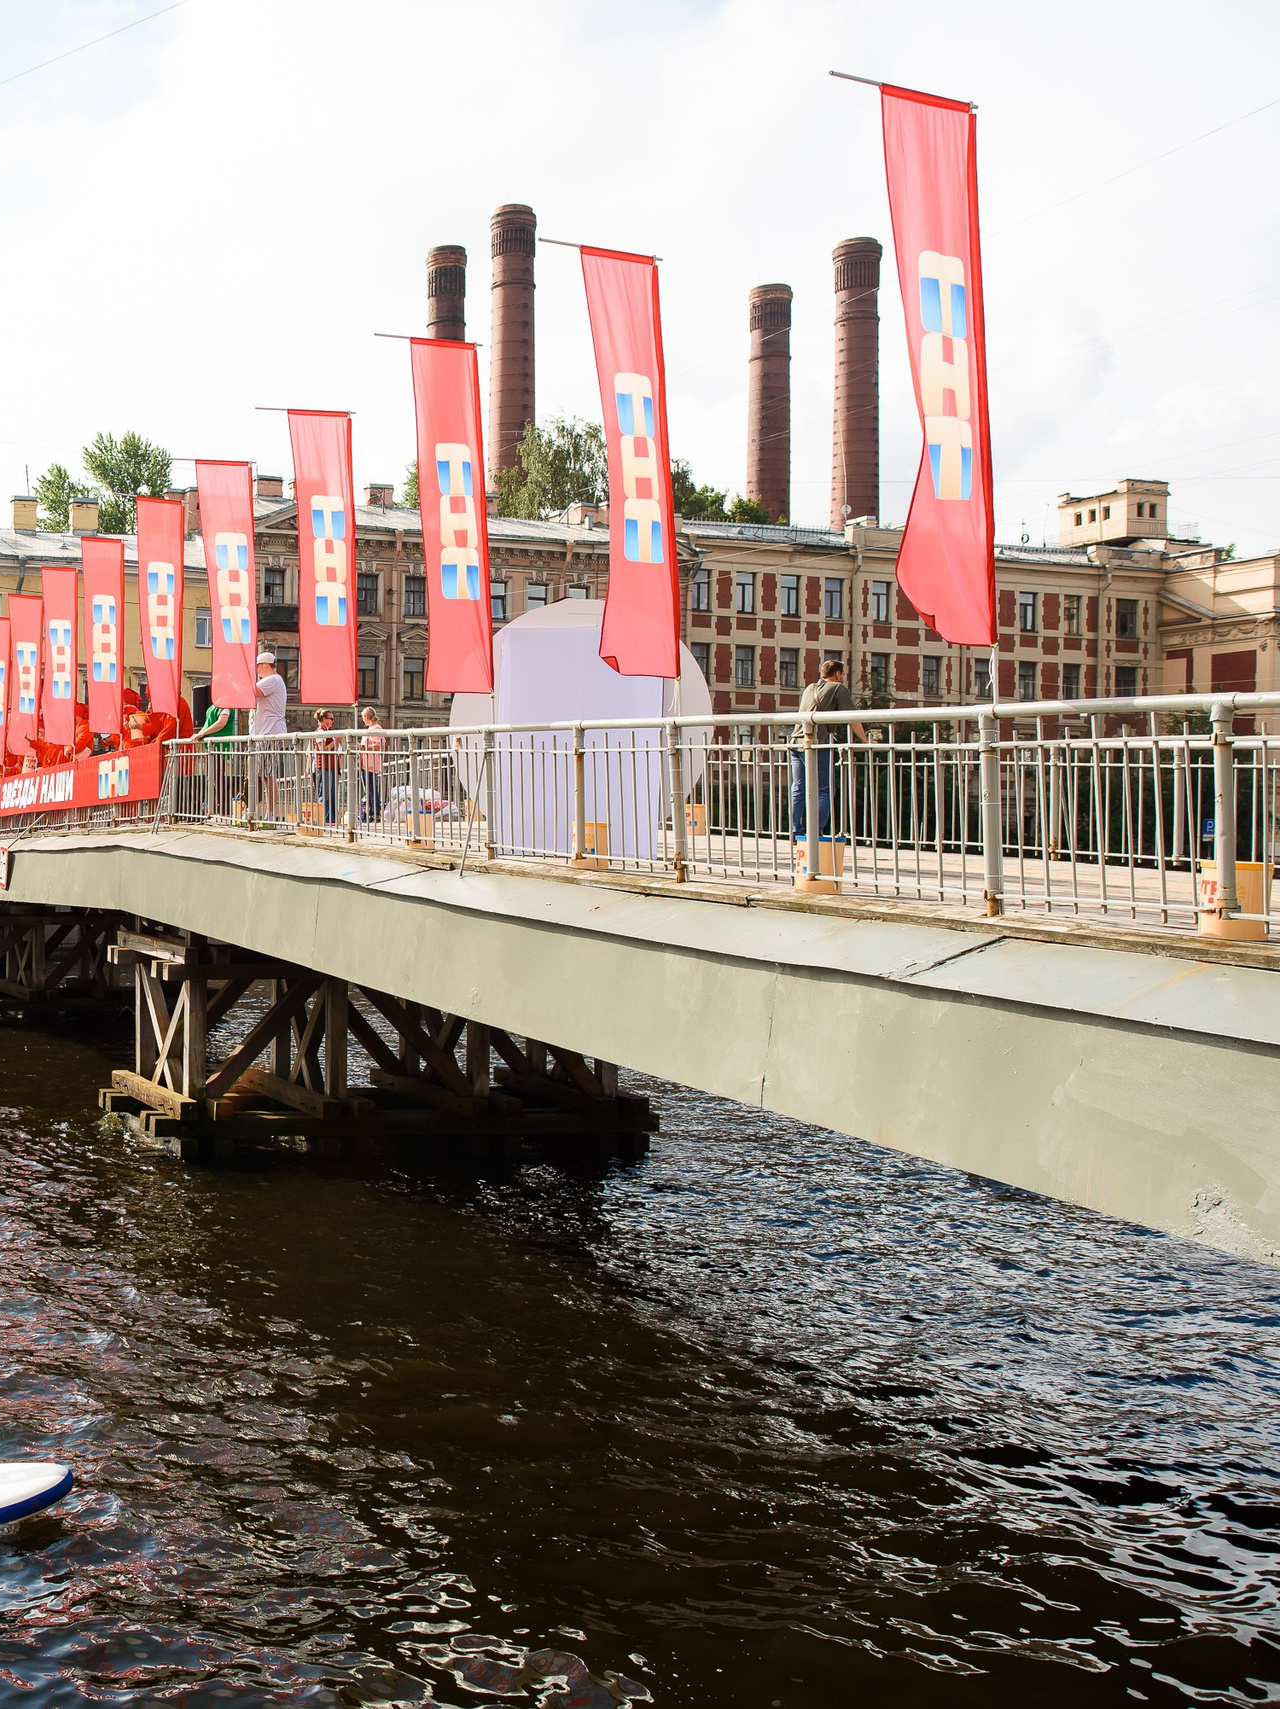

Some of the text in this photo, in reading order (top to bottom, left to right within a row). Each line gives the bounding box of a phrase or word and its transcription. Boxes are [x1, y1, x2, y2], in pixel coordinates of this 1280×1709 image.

[920, 250, 973, 500] ТНТ
[612, 373, 665, 564] ТНТ
[311, 496, 347, 625] ТНТ
[436, 443, 479, 599] ТНТ
[148, 561, 175, 659] ТНТ
[216, 533, 251, 643] ТНТ
[17, 643, 37, 714] ТНТ
[49, 620, 71, 699] ТНТ
[93, 595, 117, 682] ТНТ
[39, 769, 74, 804] НАШИ
[97, 755, 130, 800] ТНТ
